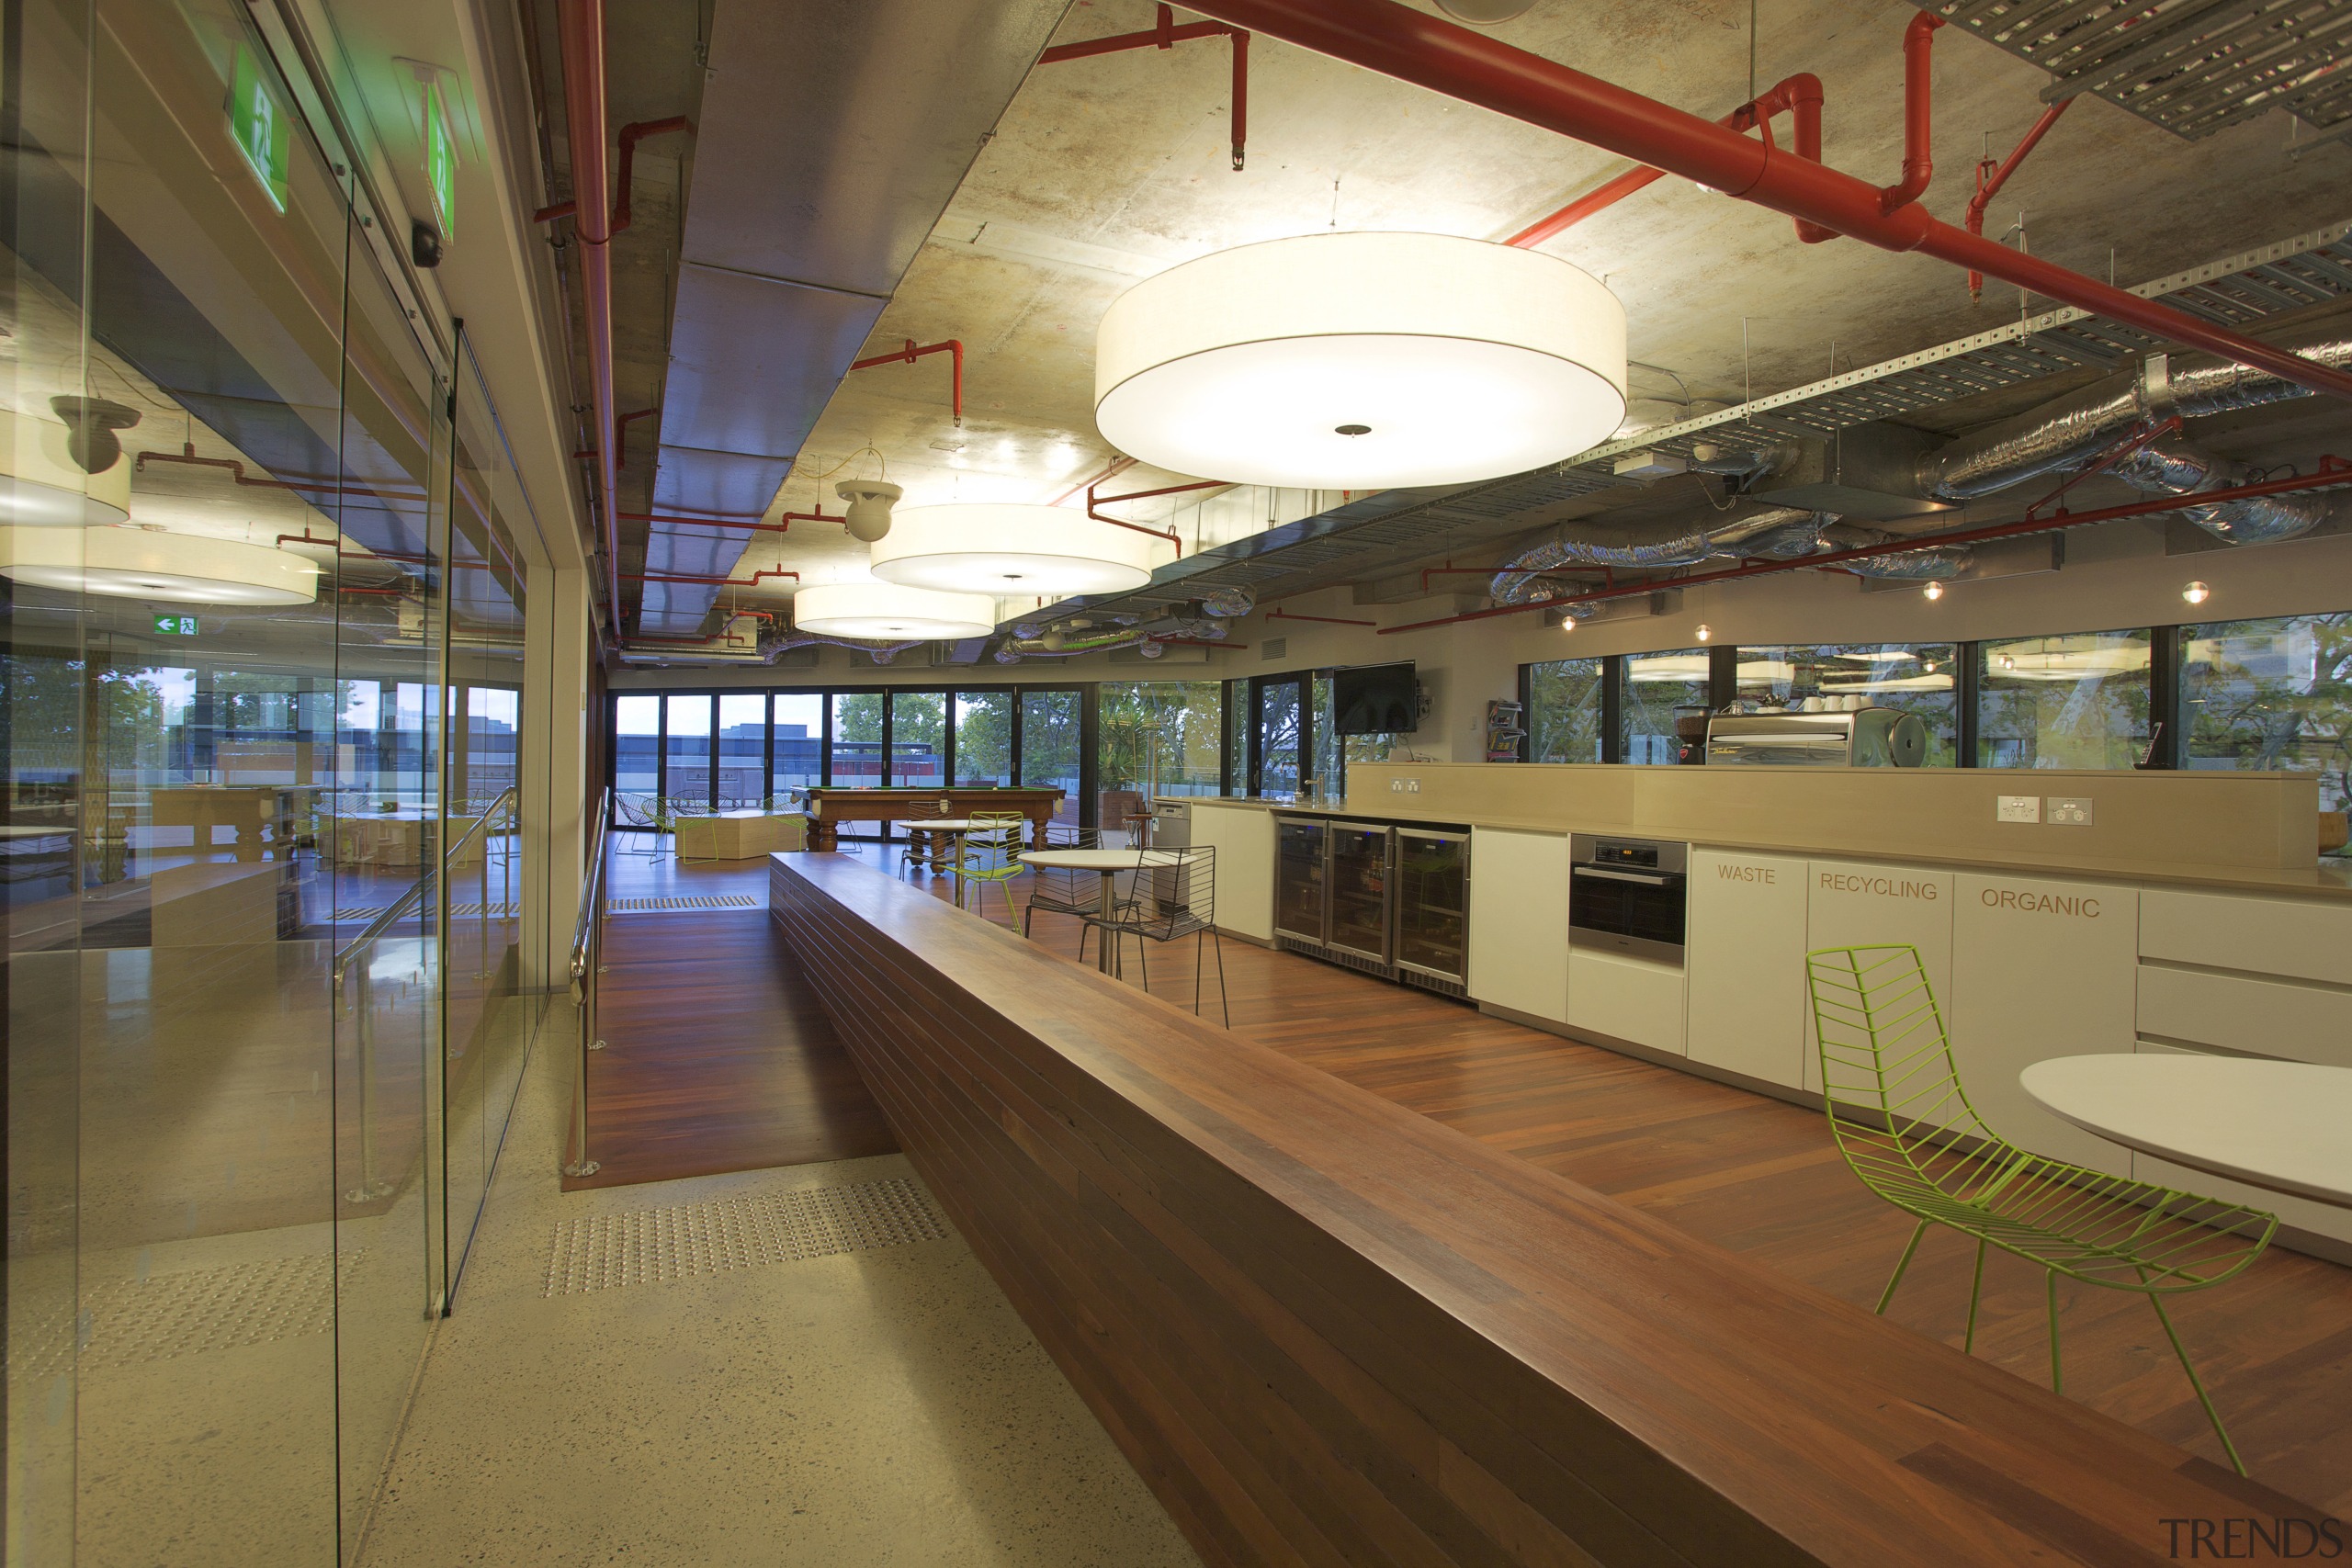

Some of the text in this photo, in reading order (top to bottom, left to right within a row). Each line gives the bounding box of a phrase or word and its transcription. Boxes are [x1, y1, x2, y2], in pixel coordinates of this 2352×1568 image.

[1717, 864, 1776, 885] WASTE
[1820, 873, 1938, 900] RECYCLING
[1981, 888, 2100, 918] ORGANIC
